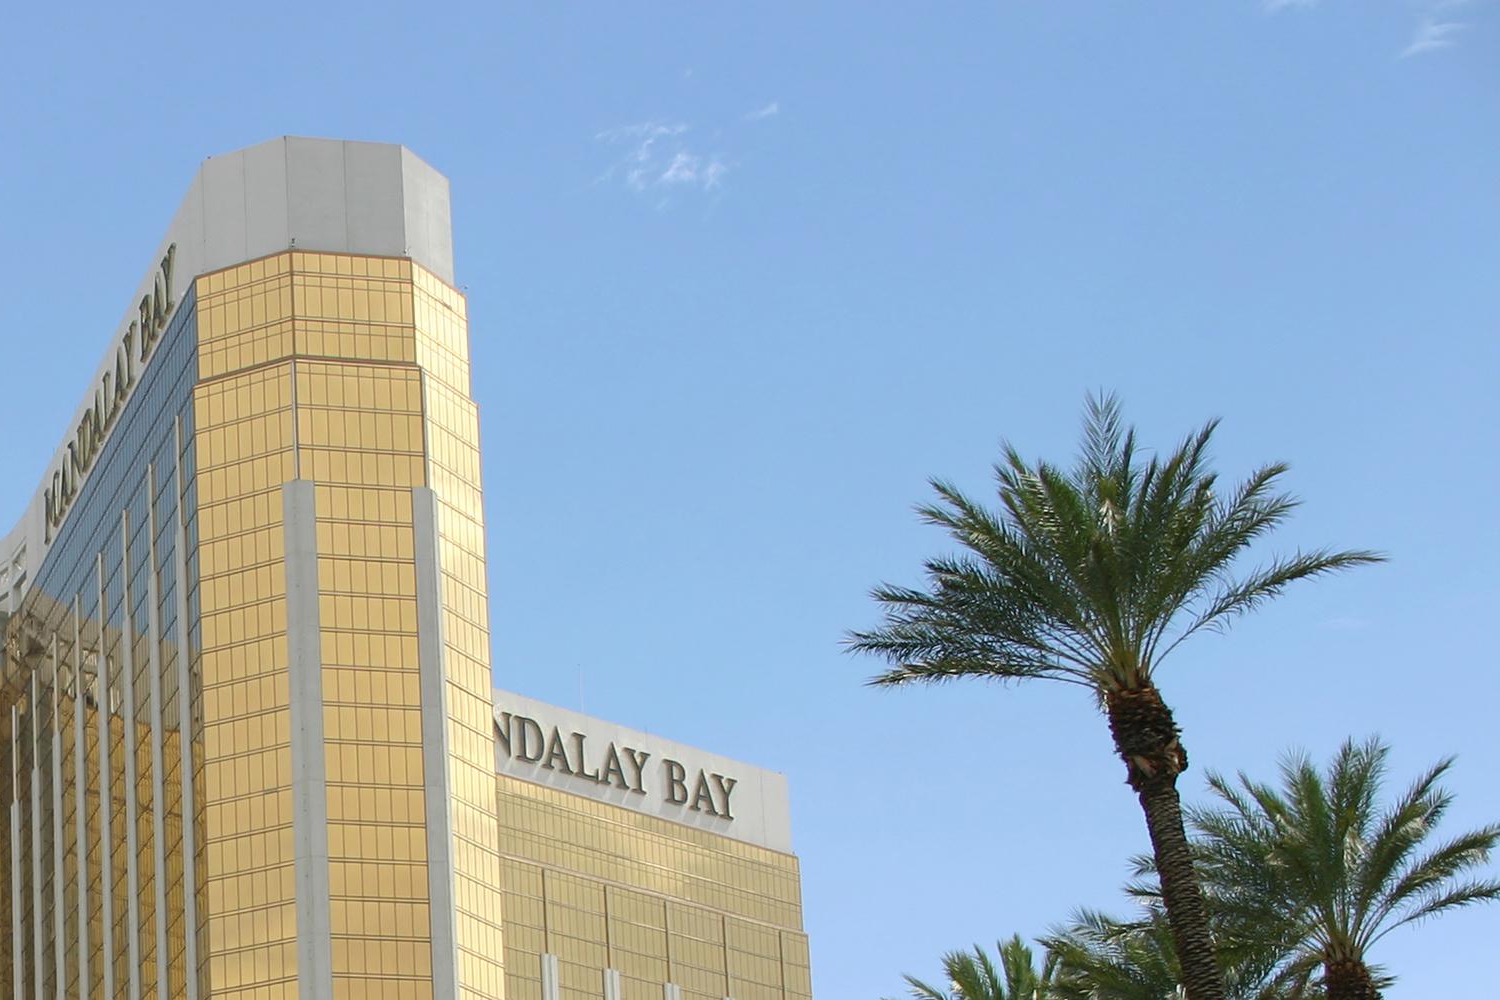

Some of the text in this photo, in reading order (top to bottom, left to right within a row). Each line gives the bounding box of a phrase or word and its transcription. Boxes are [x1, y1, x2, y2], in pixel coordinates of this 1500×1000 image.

[139, 242, 177, 363] BAY
[494, 711, 738, 821] NDALAY BAY
